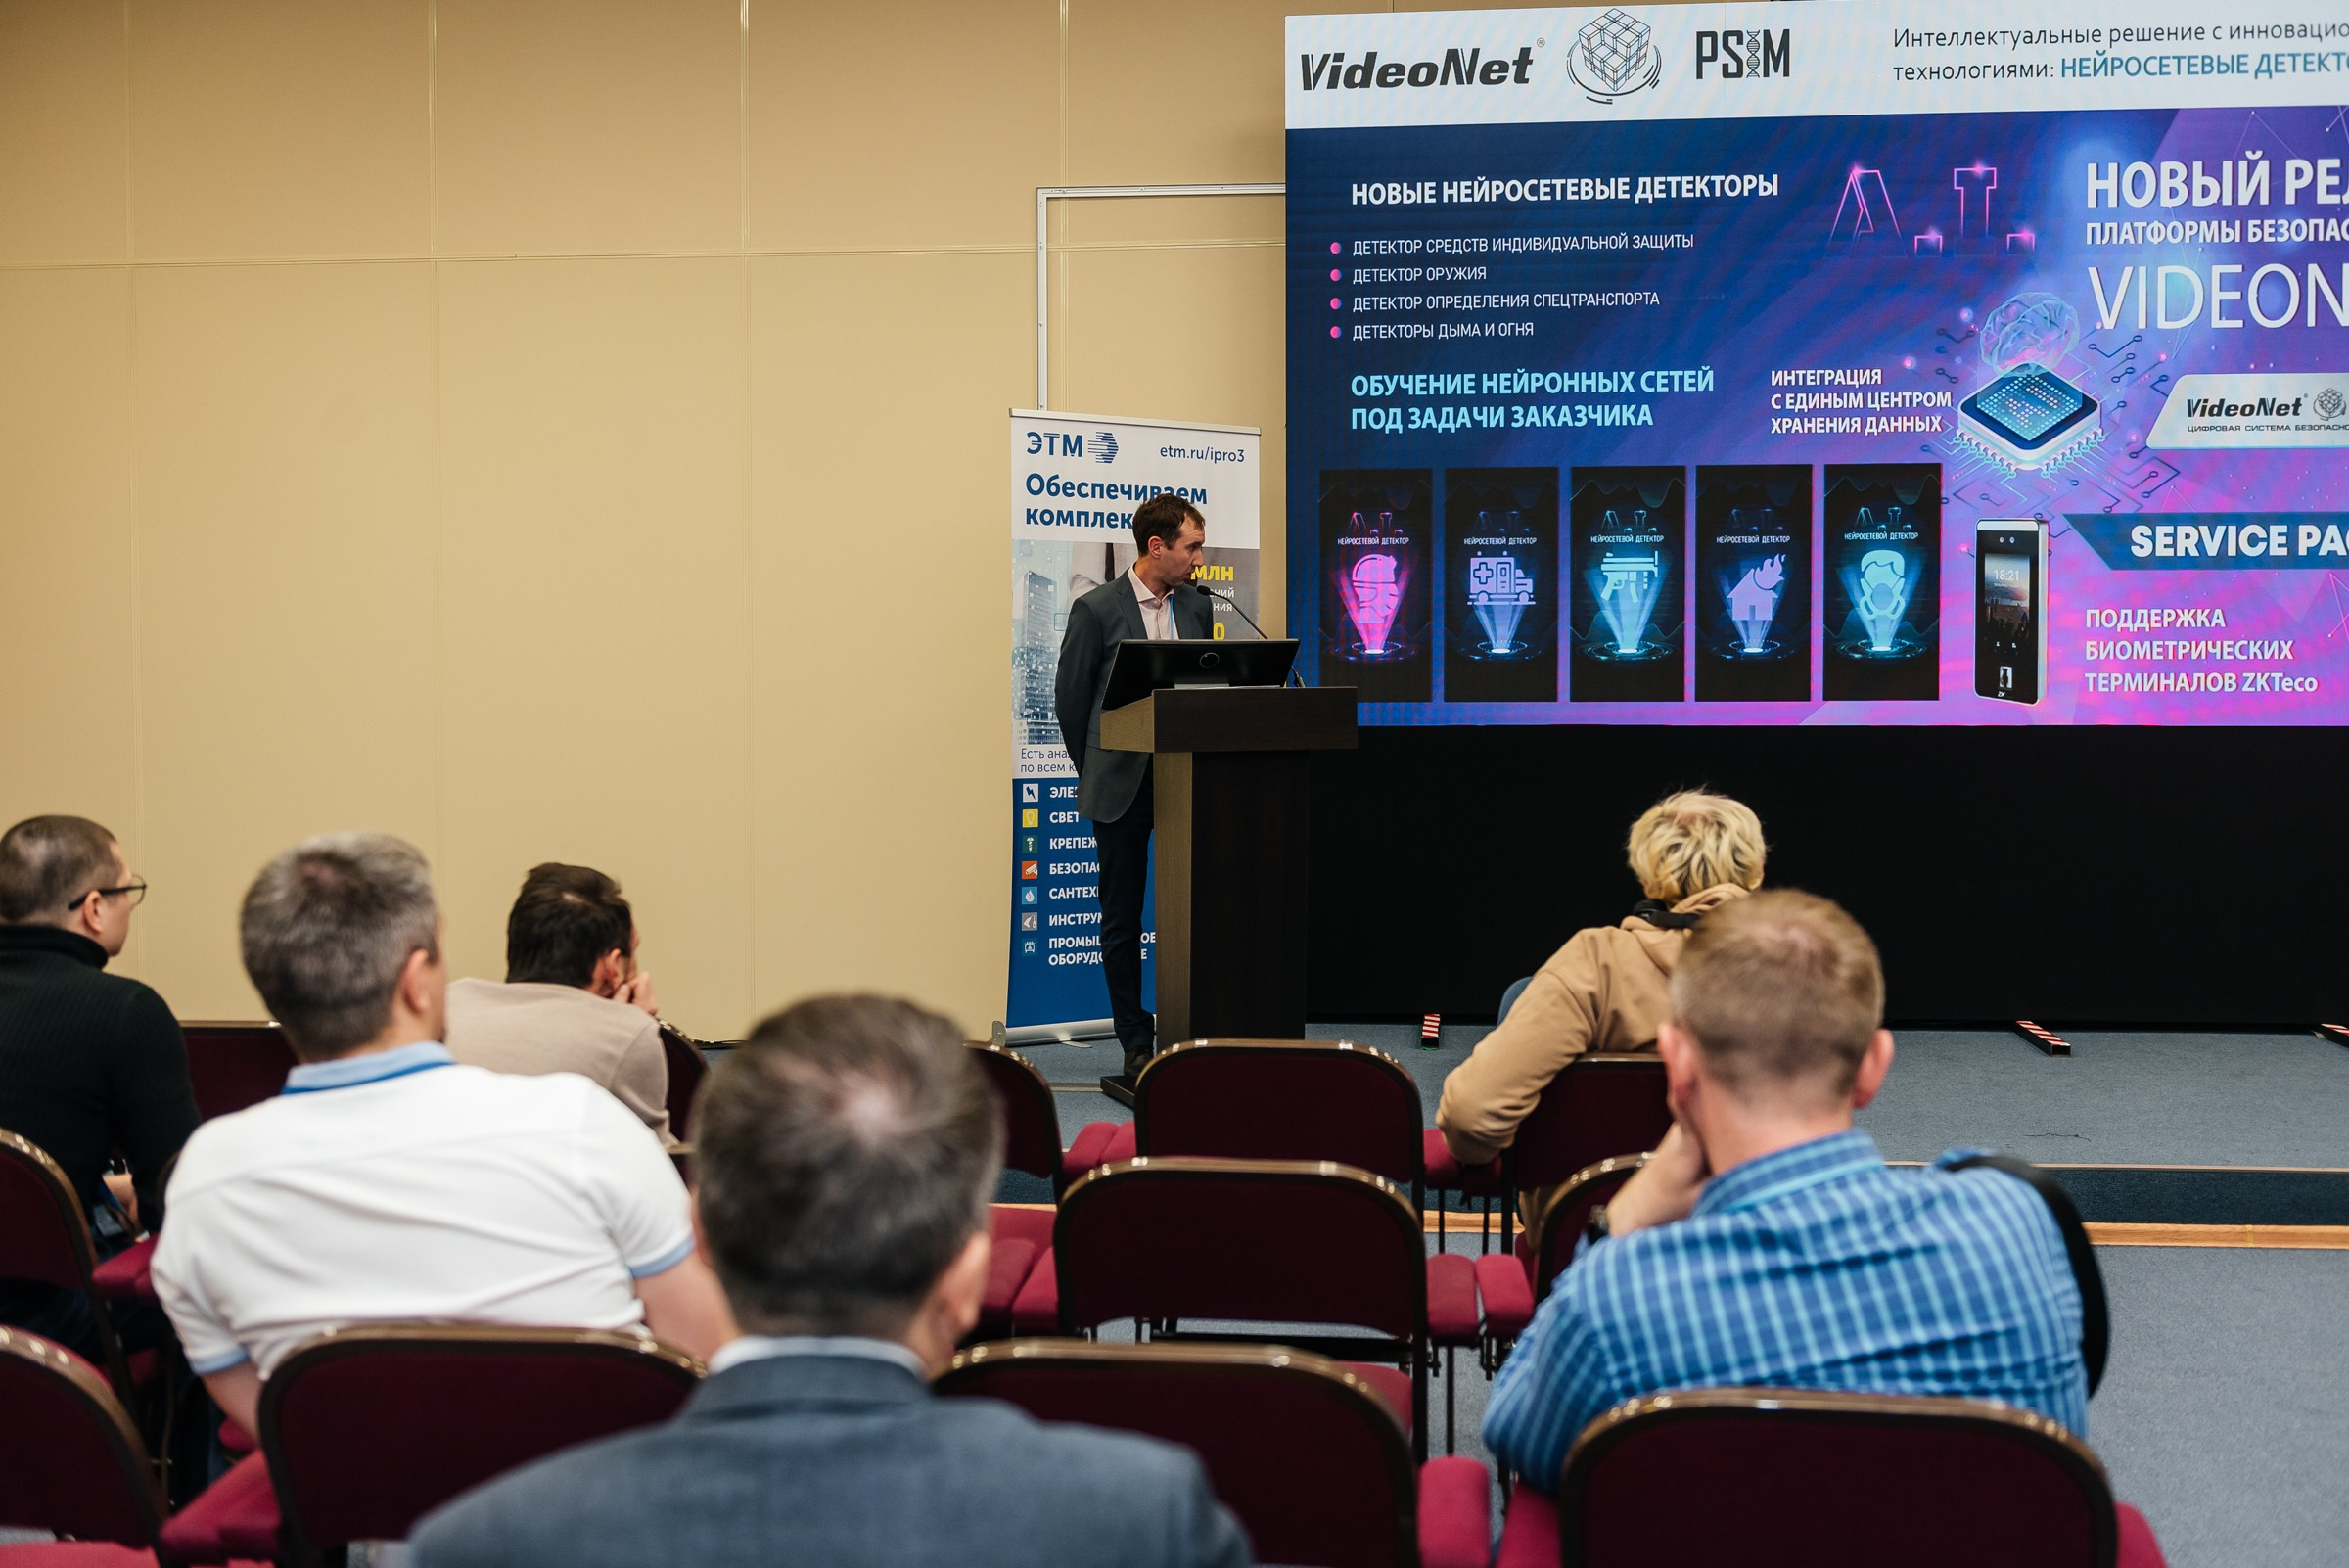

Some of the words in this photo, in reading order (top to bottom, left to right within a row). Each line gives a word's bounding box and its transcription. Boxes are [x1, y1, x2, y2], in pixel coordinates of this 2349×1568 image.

[1894, 27, 2102, 50] Интеллектуальные
[2109, 25, 2205, 49] решение
[2213, 25, 2222, 40] с
[1894, 64, 2054, 82] технологиями:
[2061, 50, 2249, 78] НЕЙРОСЕТЕВЫЕ
[2255, 52, 2349, 79] ДЕТЕКТ
[2087, 151, 2270, 208] НОВЫЙ
[2285, 159, 2349, 205] РЕ
[1352, 181, 1437, 206] НОВЫЕ
[1443, 175, 1630, 203] НЕЙРОСЕТЕВЫЕ
[1635, 174, 1779, 203] ДЕТЕКТОРЫ
[2086, 219, 2240, 245] ПЛАТФОРМЫ
[1353, 240, 1423, 256] ДЕТЕКТОР
[1426, 238, 1489, 254] СРЕДСТВ
[1492, 232, 1629, 254] ИНДИВИДУАЛЬНОЙ
[1633, 234, 1694, 251] ЗАЩИТЫ
[1353, 268, 1423, 285] ДЕТЕКТОР
[1426, 266, 1487, 282] ОРУЖИЯ
[1353, 297, 1423, 313] ДЕТЕКТОР
[1426, 295, 1530, 311] ОПРЕДЕЛЕНИЯ
[1533, 292, 1661, 310] СПЕЦТРАНСПОРТА
[2087, 263, 2349, 330] VIDEON
[1353, 324, 1434, 342] ДЕТЕКТОРЫ
[1438, 323, 1482, 340] ДЫМА
[1485, 323, 1495, 337] И
[1498, 322, 1534, 337] ОГНЯ
[1351, 374, 1476, 397] ОБУЧЕНИЕ
[1481, 368, 1635, 395] НЕЙРОННЫХ
[1640, 366, 1714, 392] СЕТЕЙ
[1771, 369, 1883, 388] ИНТЕГРАЦИЯ
[1771, 393, 1782, 410] С
[1785, 392, 1864, 412] ЕДИНЫМ
[1867, 392, 1952, 411] ЦЕНТРОМ
[2187, 397, 2302, 418] VideoNet
[1351, 407, 1403, 434] ПОД
[1407, 405, 1505, 434] ЗАДАЧИ
[1510, 403, 1654, 429] ЗАКАЗЧИКА
[1771, 417, 1861, 434] ХРАНЕНИЯ
[1865, 416, 1943, 436] ДАННЫХ
[1026, 431, 1083, 457] ЭТМ
[1160, 445, 1245, 464] etm.ru/ipro3
[1026, 508, 1134, 529] комплек
[1381, 537, 1409, 546] ДЕТЕКТОР
[1463, 536, 1507, 545] НЕЙРОСЕТЕВОЙ
[1590, 534, 1634, 543] НЕЙРОСЕТЕВОЙ
[1761, 535, 1791, 544] ДЕТЕКТОР
[1844, 531, 1888, 540] НЕЙРОСЕТЕВОЙ
[1889, 531, 1919, 540] ДЕТЕКТОР
[2130, 525, 2288, 557] SERVICE
[2298, 525, 2349, 556] PA
[1994, 569, 2019, 581] 18:21
[2086, 609, 2226, 631] ПОДДЕРЖКА
[2086, 639, 2293, 661] БИОМЕТРИЧЕСКИХ
[2086, 672, 2237, 694] ТЕРМИНАЛОВ
[2242, 672, 2318, 693] ZKTeco
[1021, 748, 1045, 759] Есть
[1020, 763, 1035, 772] по
[1037, 763, 1066, 772] всем
[1049, 787, 1079, 798] ЭЛЕ
[1049, 862, 1100, 875] БЕЗОПА
[1048, 886, 1099, 899] САНТЕХ
